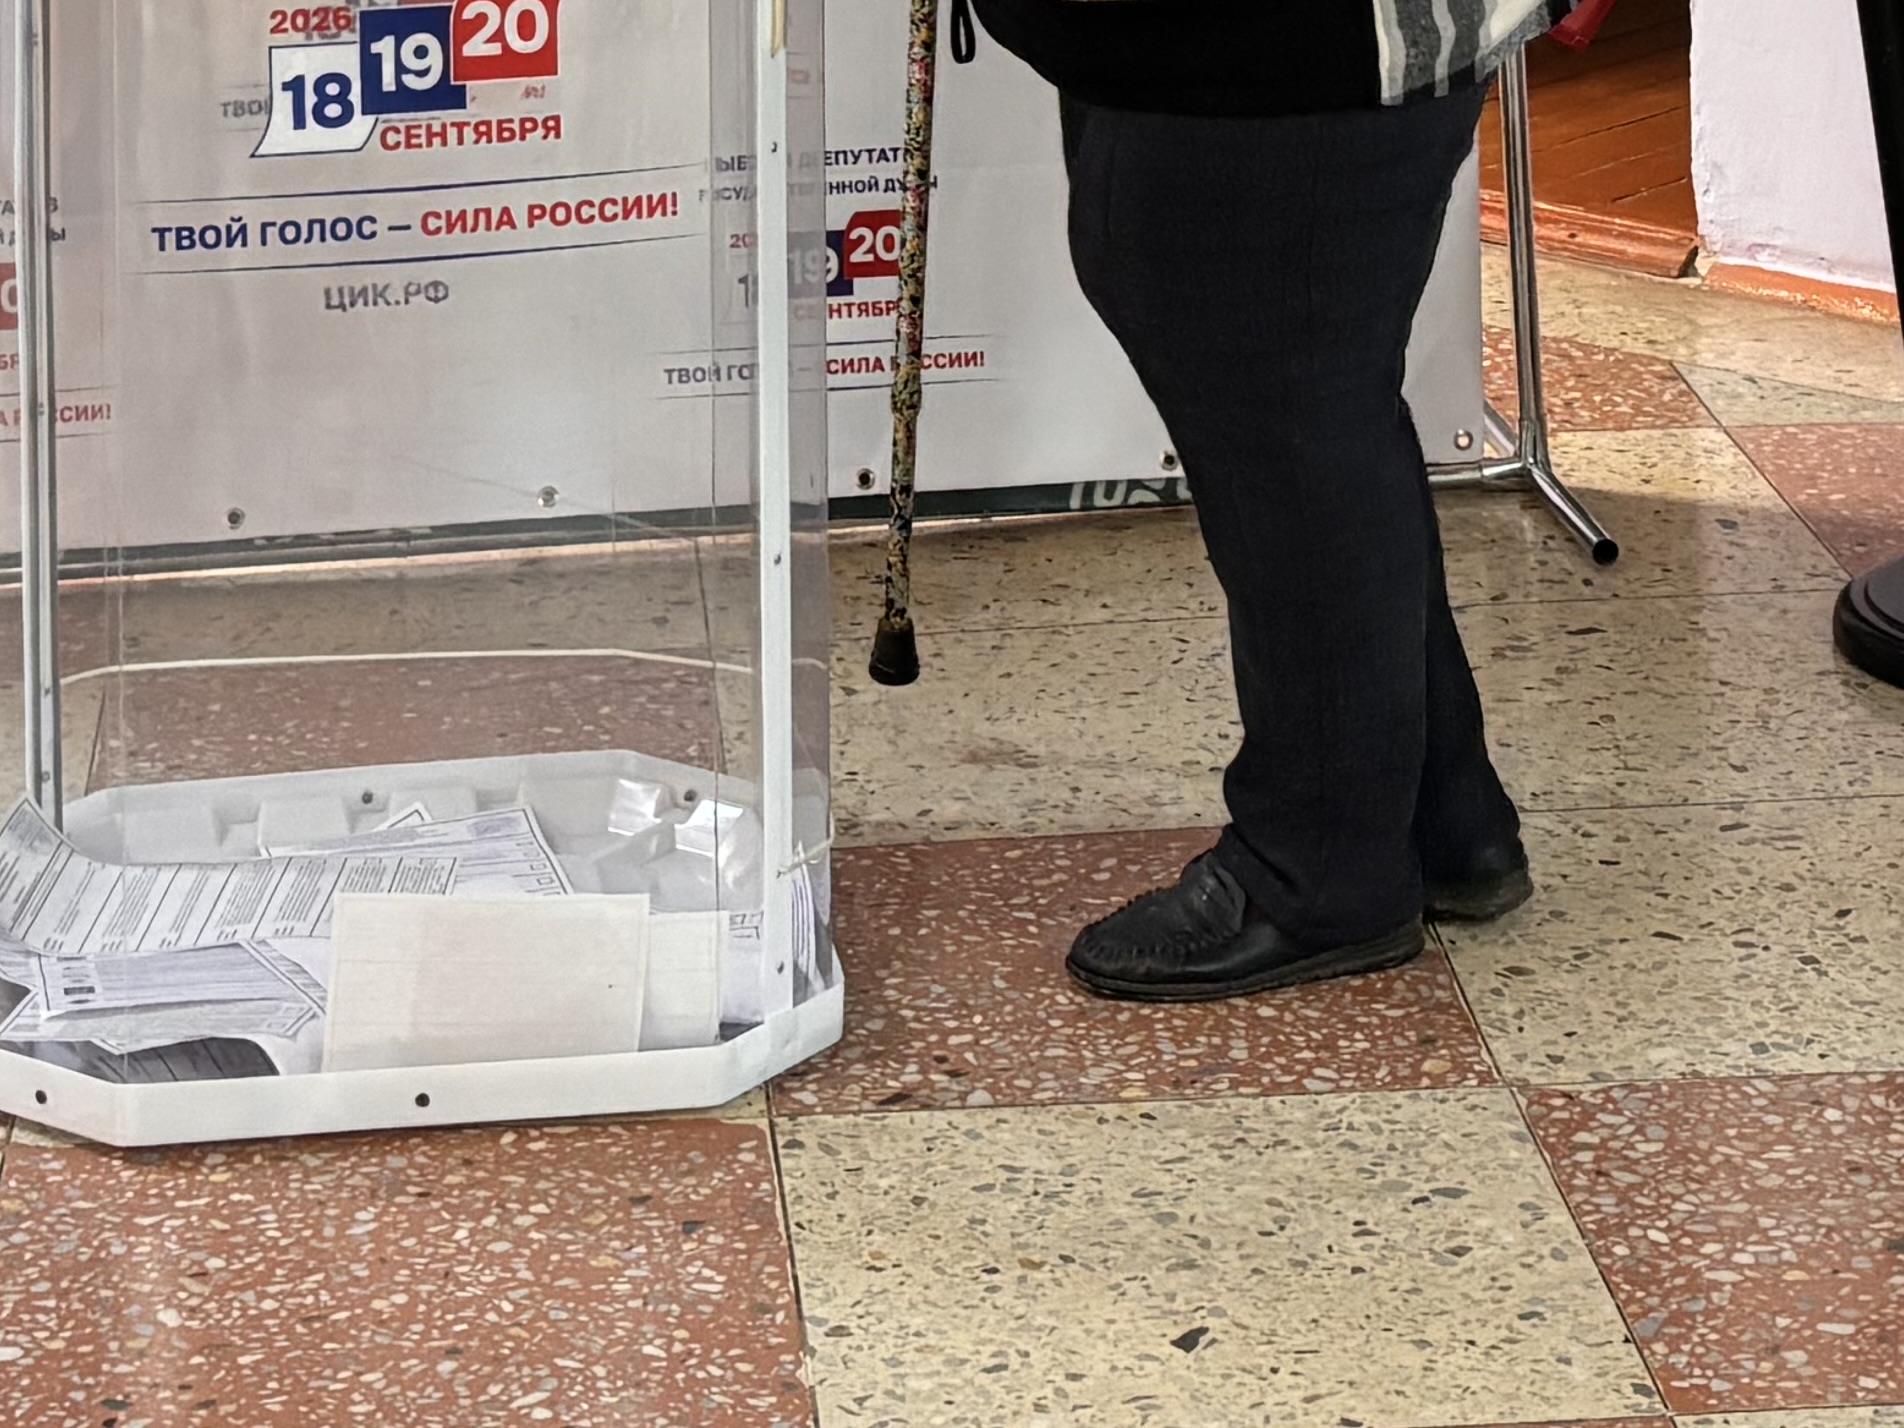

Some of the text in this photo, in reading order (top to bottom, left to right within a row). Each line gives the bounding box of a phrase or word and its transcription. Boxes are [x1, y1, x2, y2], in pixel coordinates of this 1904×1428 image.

[269, 6, 352, 36] 2026
[370, 33, 444, 91] 19
[281, 72, 354, 131] 18
[379, 114, 563, 152] СЕНТЯБРЯ
[151, 216, 249, 253] ТВОЙ
[259, 214, 378, 247] ГОЛОС
[420, 203, 520, 238] СИЛА
[526, 191, 680, 230] РОССИИ!
[324, 280, 449, 312] ЦИК.РФ
